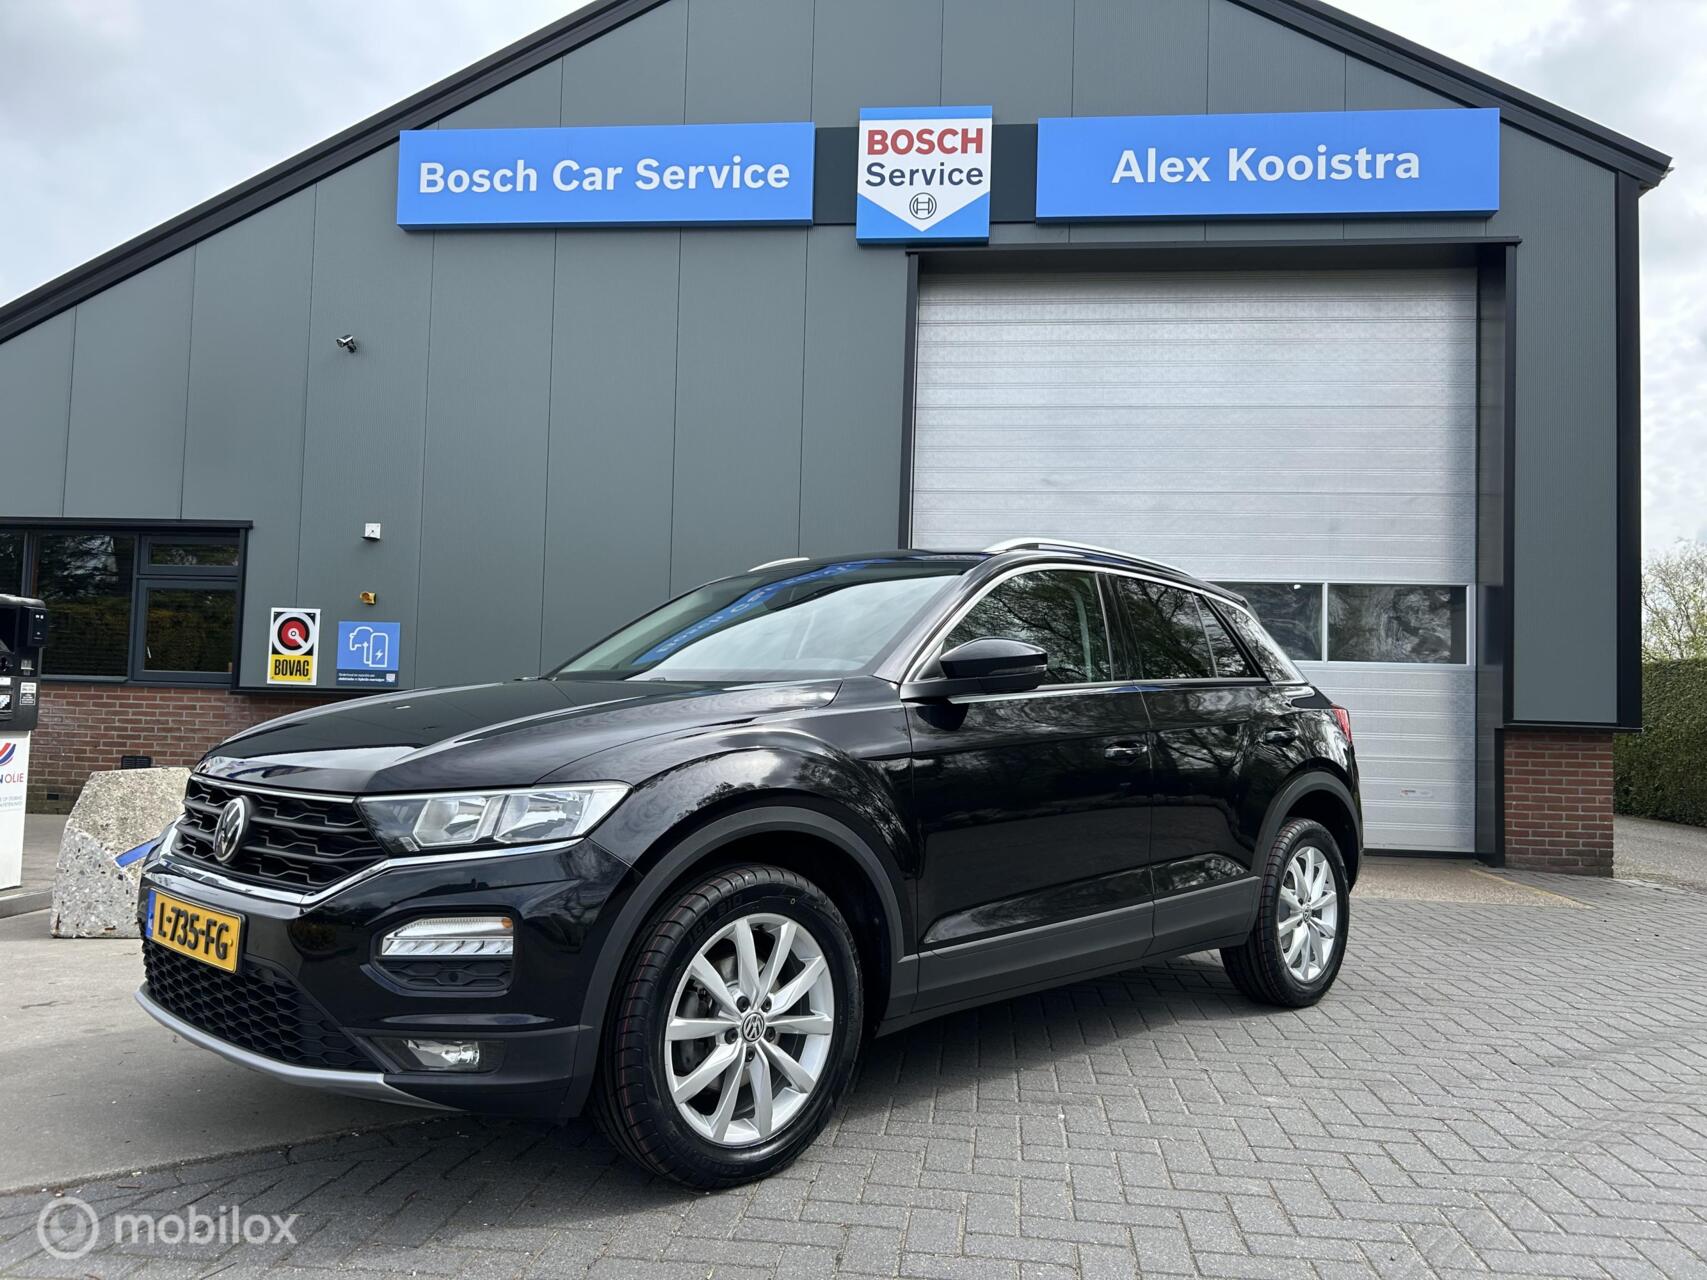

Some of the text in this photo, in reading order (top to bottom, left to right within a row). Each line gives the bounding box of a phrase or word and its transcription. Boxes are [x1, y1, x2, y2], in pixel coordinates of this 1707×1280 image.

[867, 128, 984, 155] BOSCH
[419, 155, 790, 194] Bosch Car Service
[865, 161, 984, 187] Service
[1111, 144, 1421, 184] Alex Kooistra
[274, 658, 310, 677] BOVAG
[158, 902, 230, 960] L-735-FG
